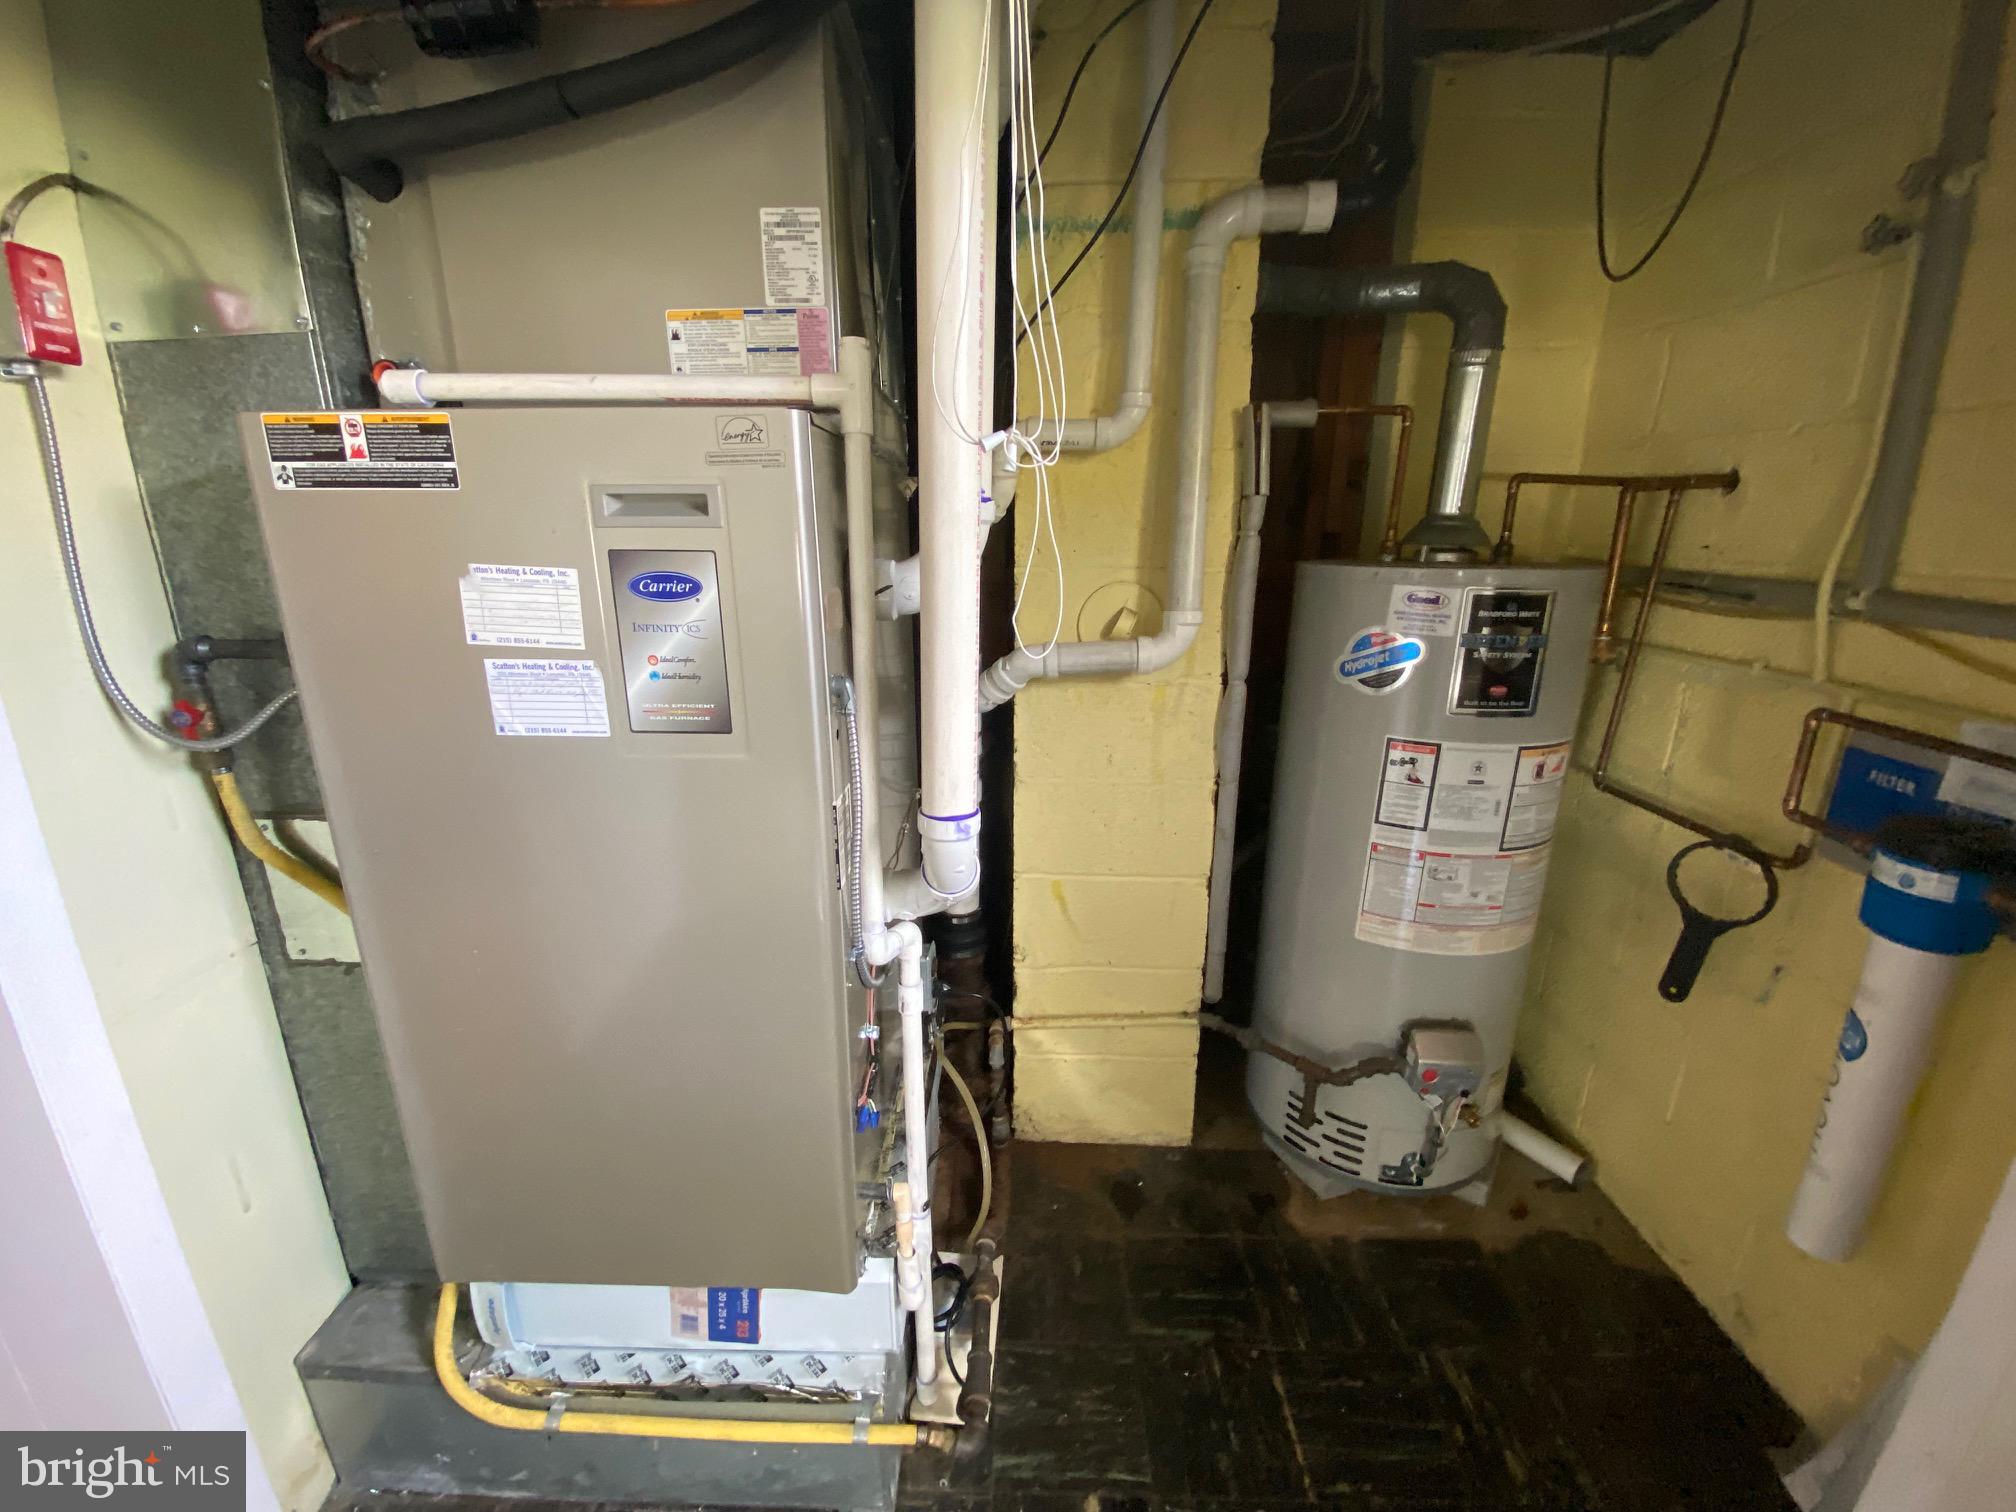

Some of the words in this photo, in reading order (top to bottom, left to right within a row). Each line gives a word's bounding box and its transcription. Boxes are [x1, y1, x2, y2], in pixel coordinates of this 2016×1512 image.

[495, 567, 520, 577] Heating
[522, 567, 527, 575] &
[530, 568, 556, 578] Cooling,
[557, 569, 570, 577] Inc.
[639, 579, 693, 593] Carrier
[632, 622, 680, 633] INFINITY
[496, 637, 512, 645] (215)
[492, 661, 520, 671] Scatton's
[522, 662, 547, 672] Heating
[548, 662, 553, 670] &
[1344, 651, 1391, 674] Hydrojet
[1868, 768, 1917, 798] FILTER
[718, 1291, 727, 1301] 20
